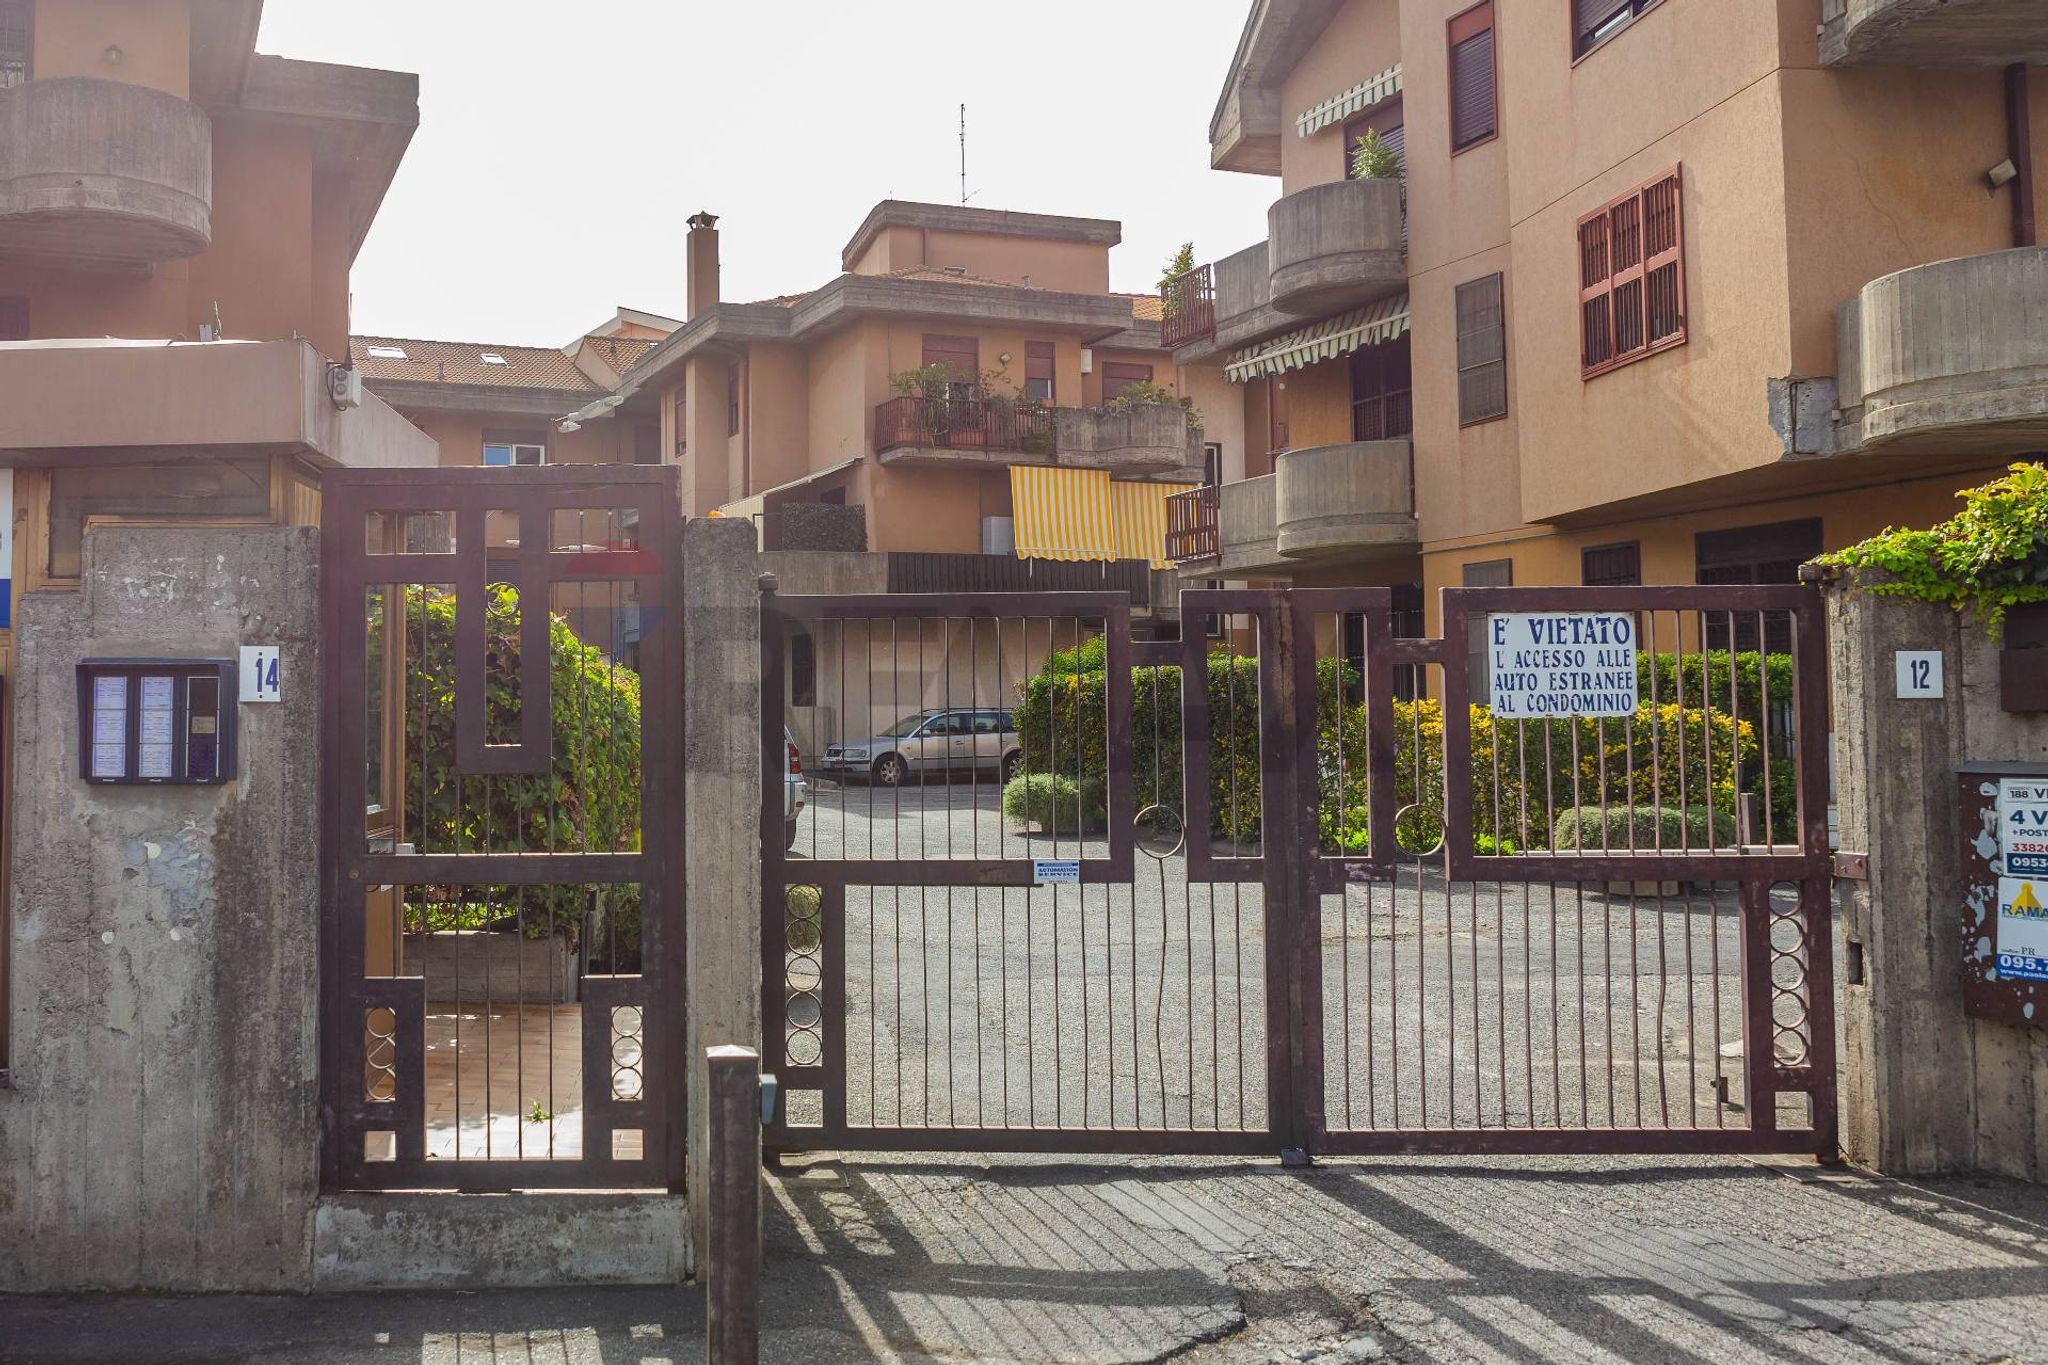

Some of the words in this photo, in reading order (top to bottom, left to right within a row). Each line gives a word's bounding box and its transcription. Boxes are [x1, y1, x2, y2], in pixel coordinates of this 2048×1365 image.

[1527, 616, 1631, 646] VIETATO
[1514, 649, 1586, 669] ACCESSO
[1596, 648, 1632, 668] ALLE
[255, 657, 280, 694] 14
[1494, 672, 1538, 692] AUTO
[1549, 671, 1634, 691] ESTRANEE
[1910, 659, 1930, 689] 12
[1497, 694, 1516, 713] AL
[1526, 693, 1633, 713] CONDOMINIO
[2009, 790, 2029, 799] 188
[2009, 809, 2026, 825] 4
